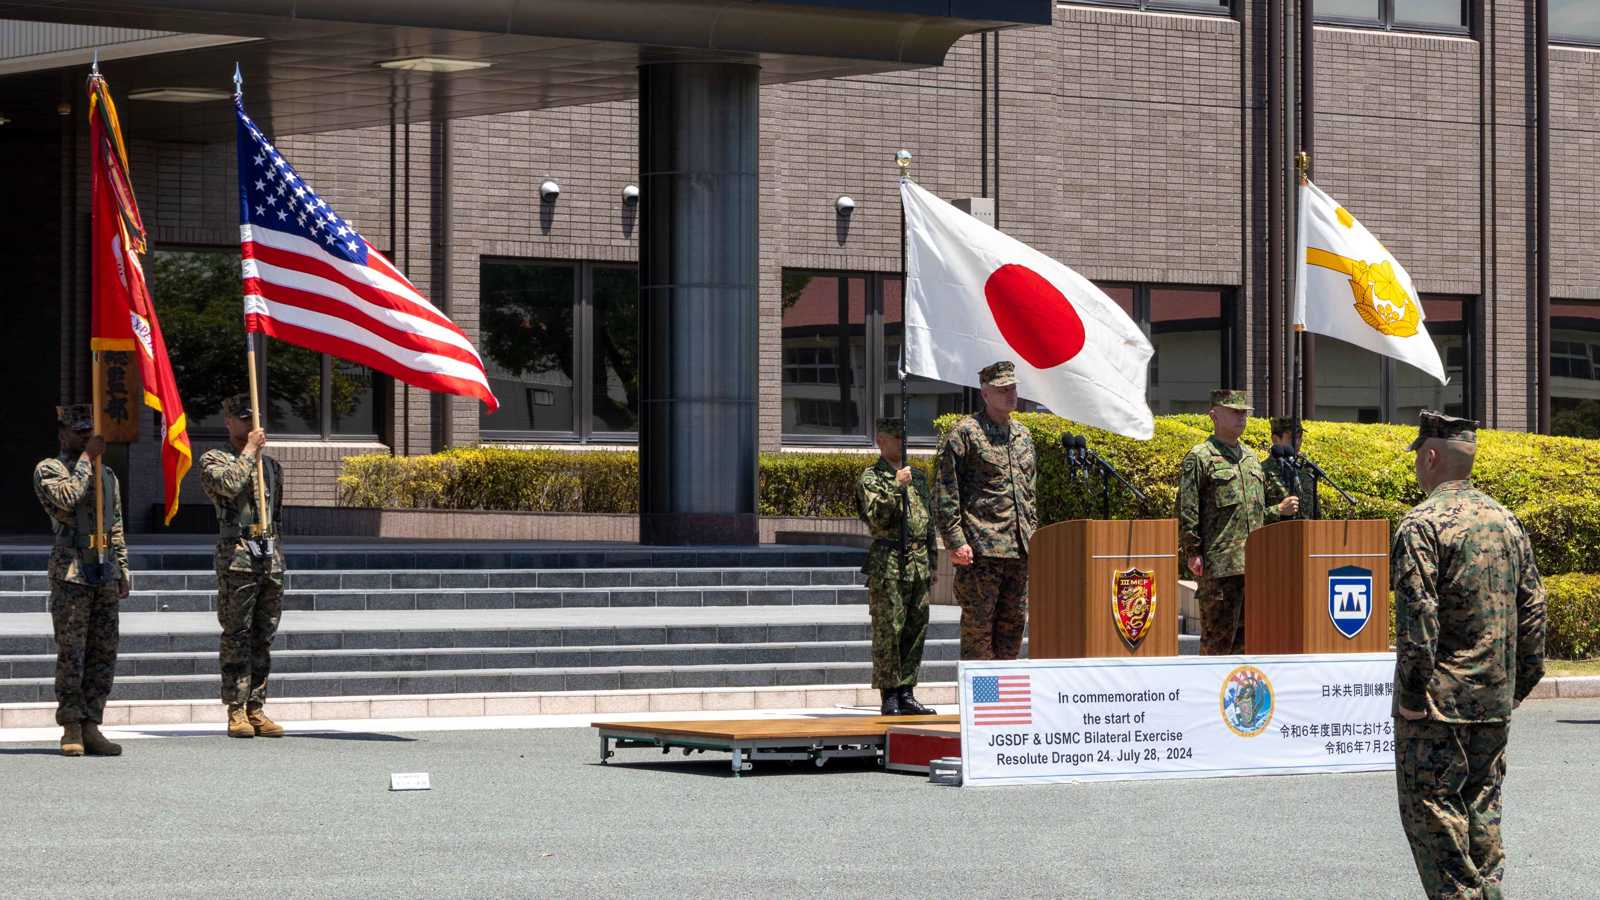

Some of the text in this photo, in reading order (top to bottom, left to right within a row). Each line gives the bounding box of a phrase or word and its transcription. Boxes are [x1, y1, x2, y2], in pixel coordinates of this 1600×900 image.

[1059, 689, 1179, 703] In commemoration of
[1083, 712, 1145, 725] the start of
[1279, 721, 1395, 738] 令和6年度国内における
[988, 730, 1182, 746] JGSDF & USMC Bilateral Exercise
[997, 753, 1048, 765] Resolute
[1052, 752, 1093, 766] Dragon
[1117, 749, 1140, 764] July
[1167, 747, 1192, 759] 2024
